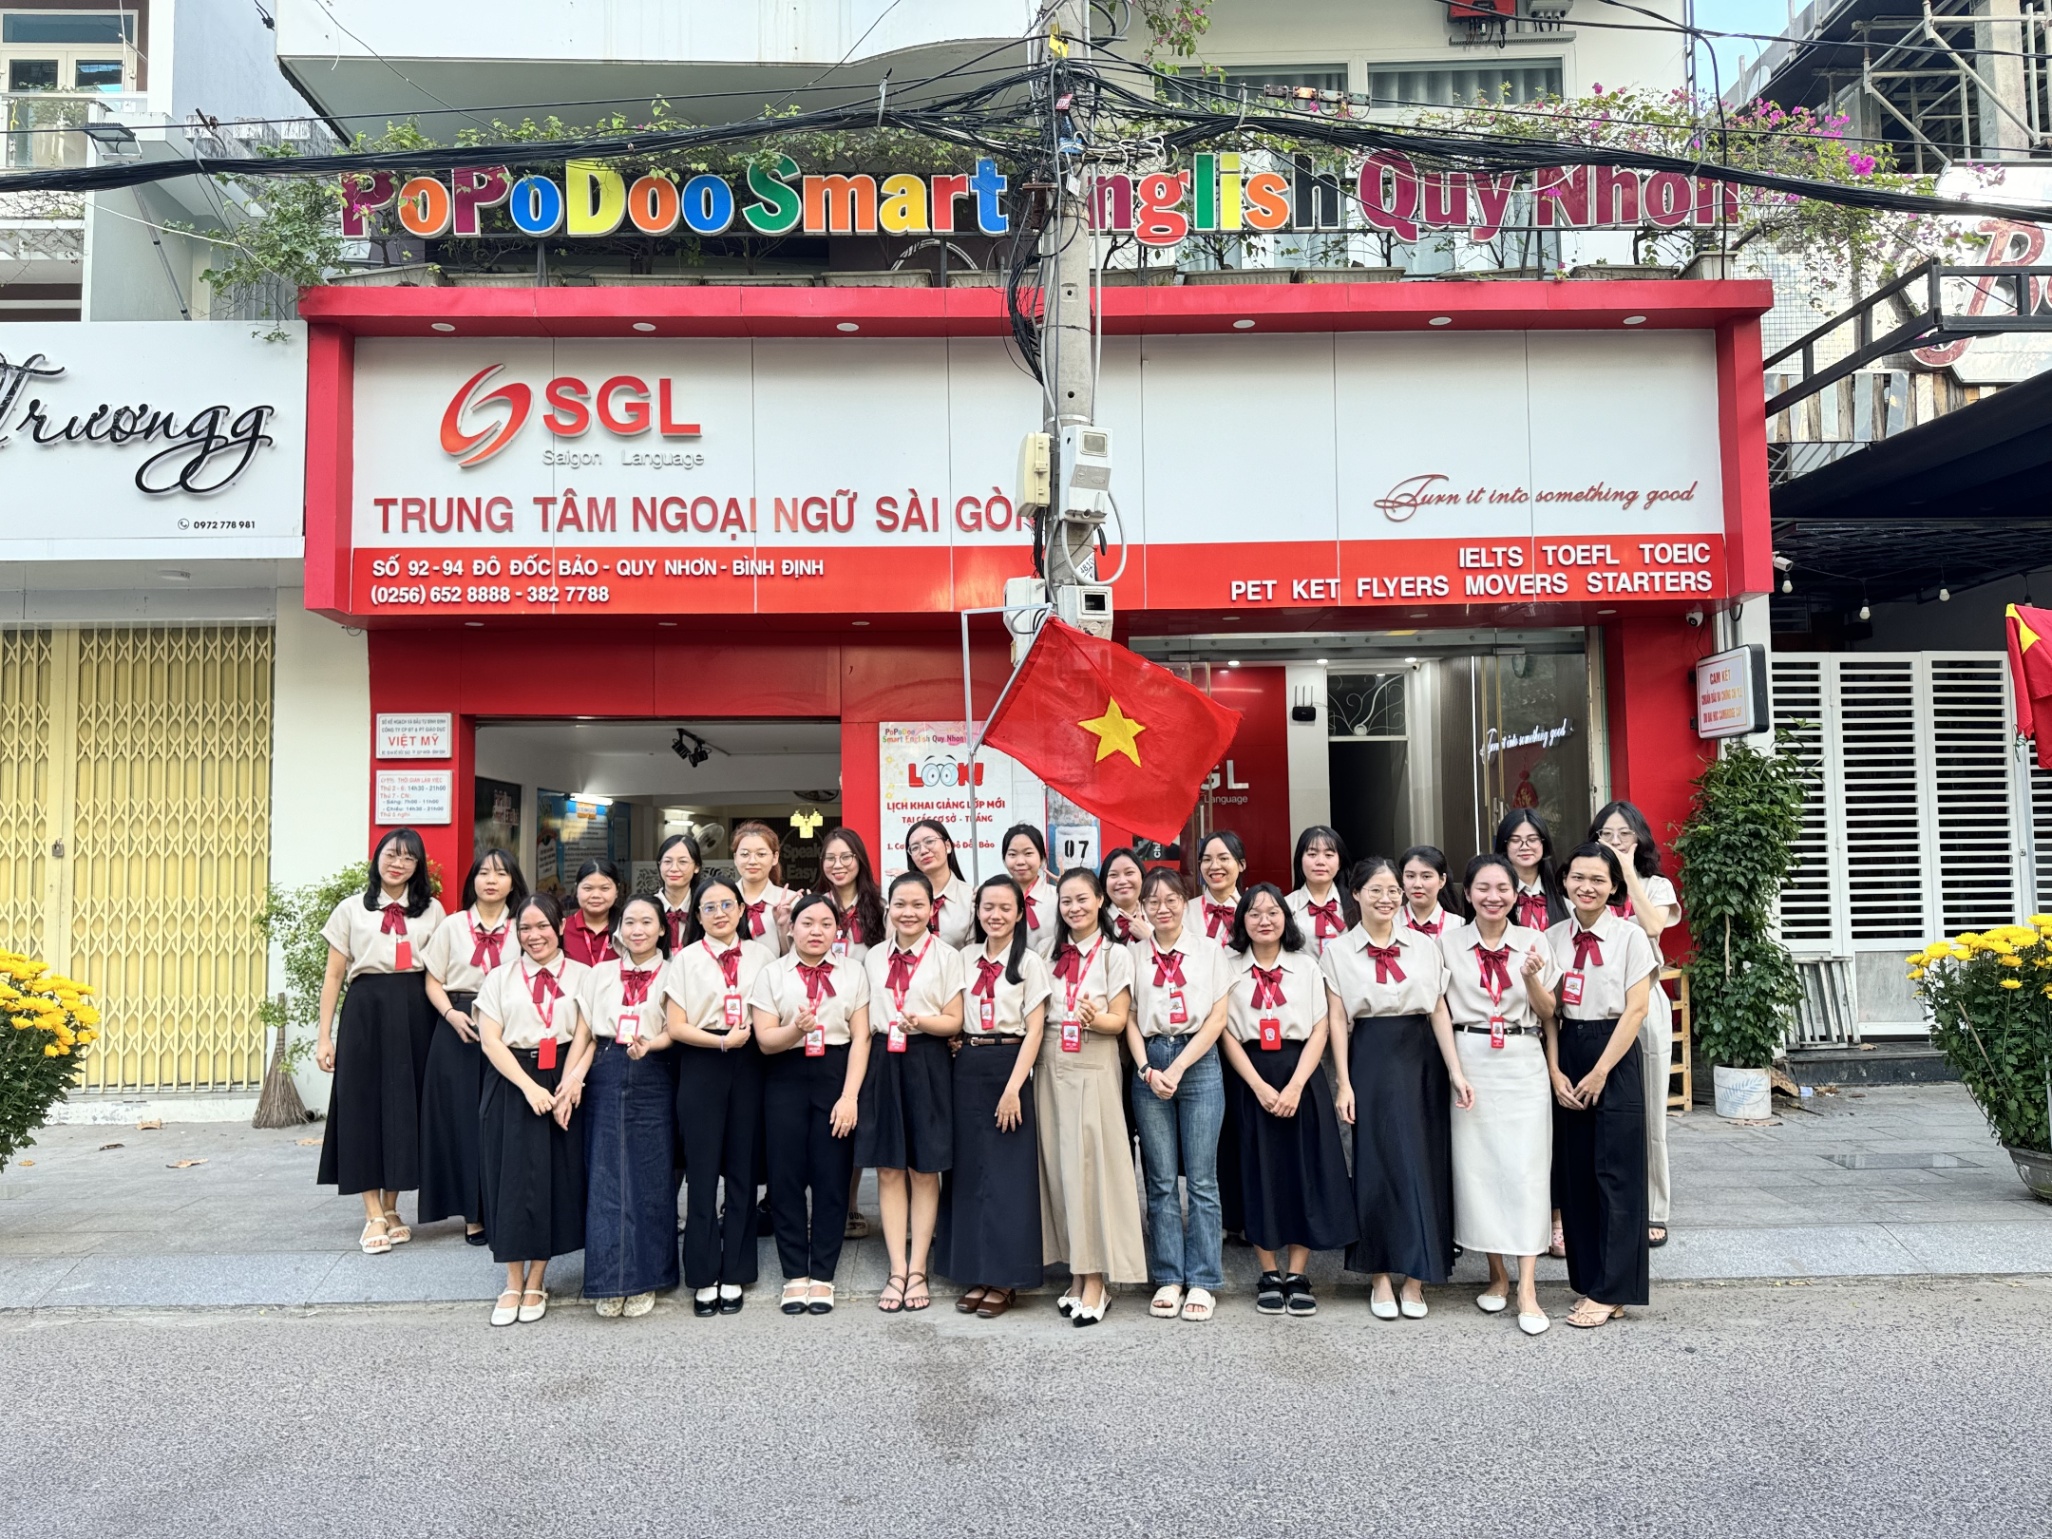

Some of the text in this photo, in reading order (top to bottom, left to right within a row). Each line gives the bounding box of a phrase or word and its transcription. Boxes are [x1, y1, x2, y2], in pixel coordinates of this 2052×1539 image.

[1088, 151, 1344, 246] nglish
[1357, 150, 1517, 243] Quy
[543, 375, 702, 437] SGL
[543, 450, 704, 470] Saigon Language
[1374, 474, 1698, 522] Turn it into something good
[374, 497, 513, 533] TRUNG
[533, 488, 616, 532] TÂM
[632, 496, 757, 540] NGOẠI
[774, 489, 857, 532] NGỮ
[876, 489, 939, 532] SÀI
[193, 521, 255, 530] 0972 778 981
[372, 554, 400, 577] SỐ
[472, 556, 501, 576] ĐÔ
[510, 554, 551, 576] ĐỐC
[558, 555, 598, 576] BẢO
[616, 560, 656, 577] QUY
[664, 558, 717, 576] NHƠN
[732, 556, 775, 576] BÌNH
[781, 560, 824, 578] ĐỊNH
[1459, 543, 1710, 568] IELTS TOEFL TOEIC
[371, 584, 426, 604] (0256)
[430, 586, 461, 602] 652
[467, 586, 511, 602] 8888
[527, 586, 559, 602] 382
[565, 586, 609, 602] 7788
[1231, 571, 1712, 600] PET KET FLYERS MOVERS STARTERS
[388, 733, 439, 748] VIỆT MỸ
[1200, 759, 1249, 790] GL
[886, 801, 908, 813] LỊCH
[910, 801, 934, 810] KHAI
[936, 798, 965, 809] GIẢNG
[986, 797, 1005, 808] MỚI
[902, 816, 914, 826] TẠI
[1065, 840, 1089, 858] 07
[786, 864, 818, 883] Easy
